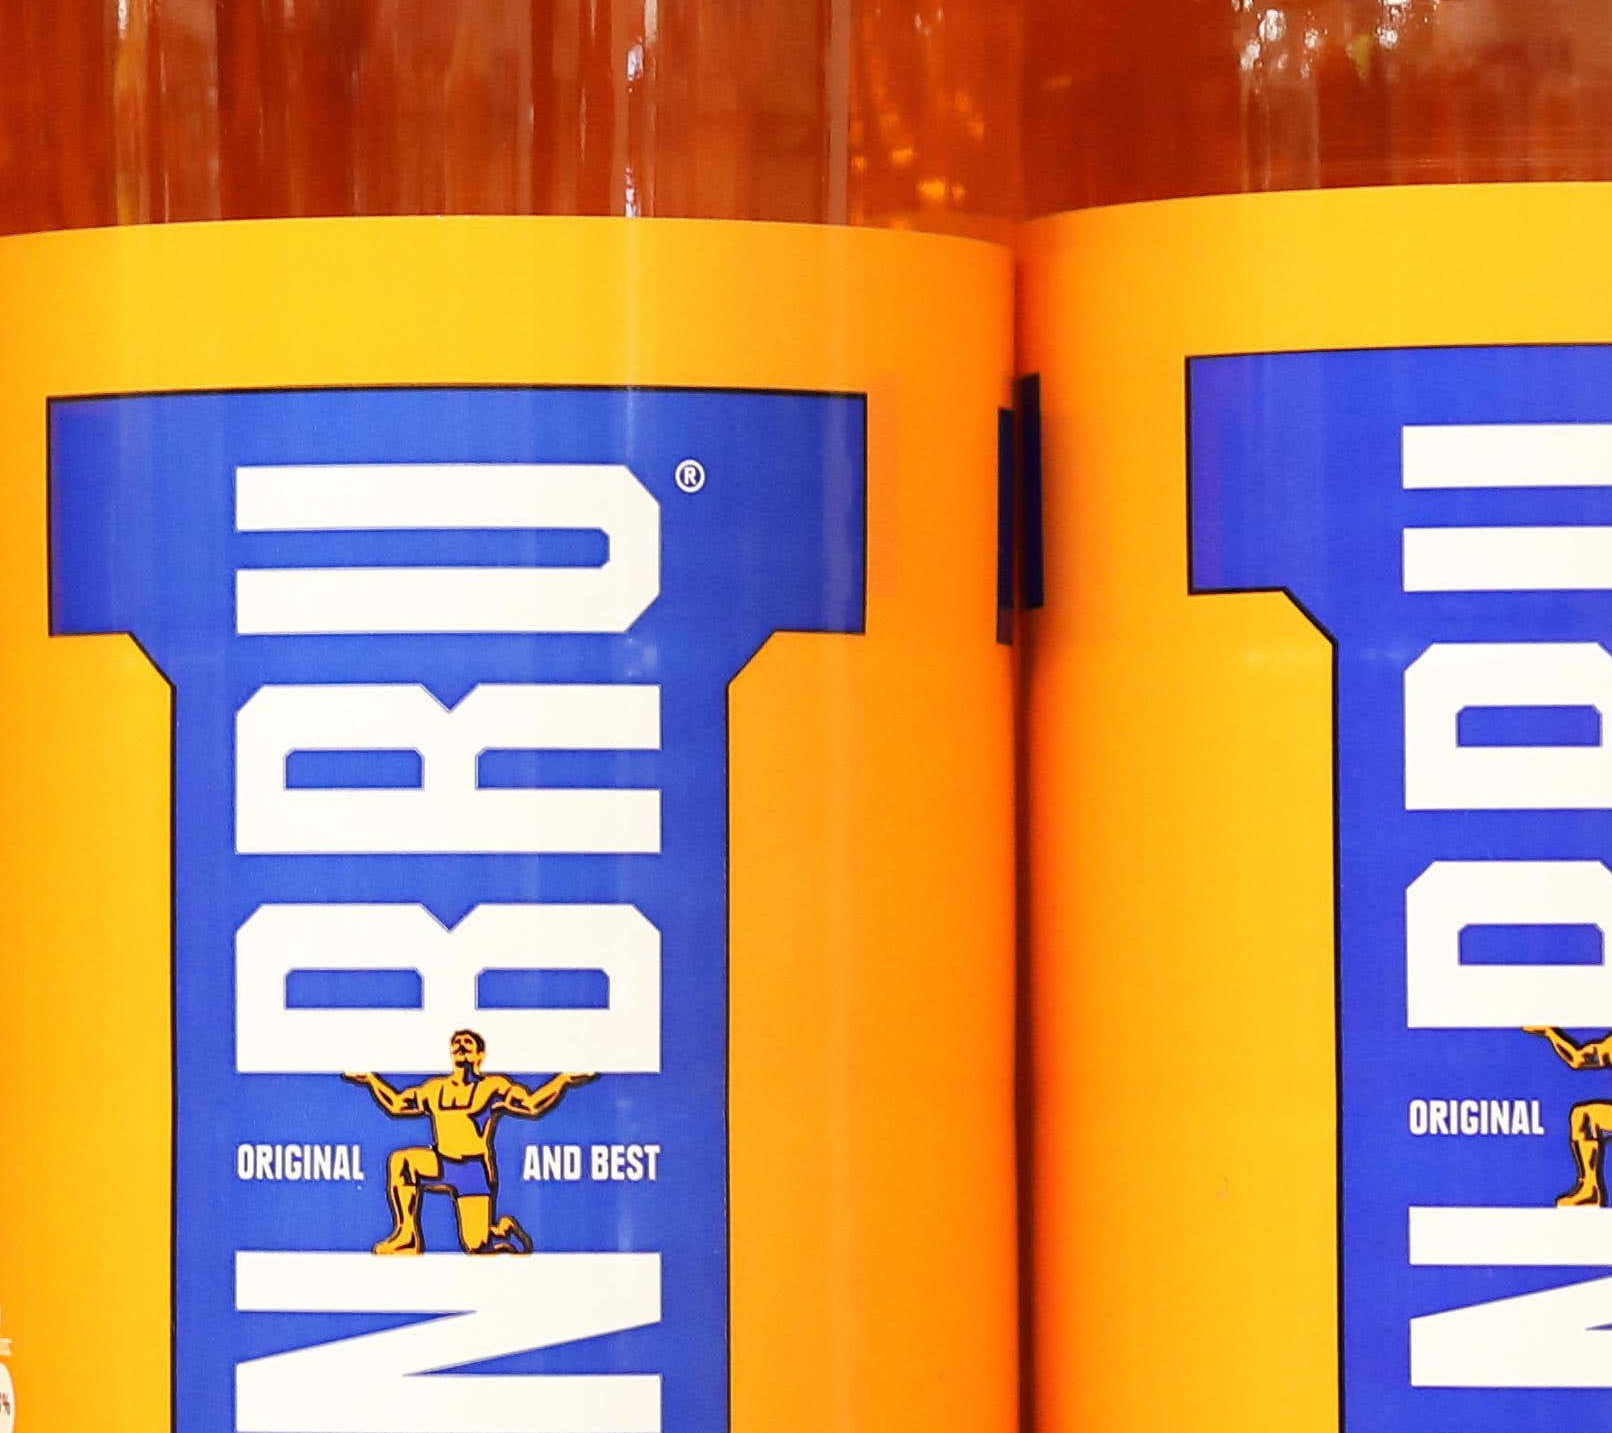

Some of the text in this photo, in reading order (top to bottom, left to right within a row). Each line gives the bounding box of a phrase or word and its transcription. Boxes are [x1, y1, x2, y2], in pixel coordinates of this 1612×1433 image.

[235, 463, 661, 1075] BRU
[1410, 1100, 1544, 1135] ORIGINAL
[238, 1144, 660, 1180] ORIGINAL AND BEST
